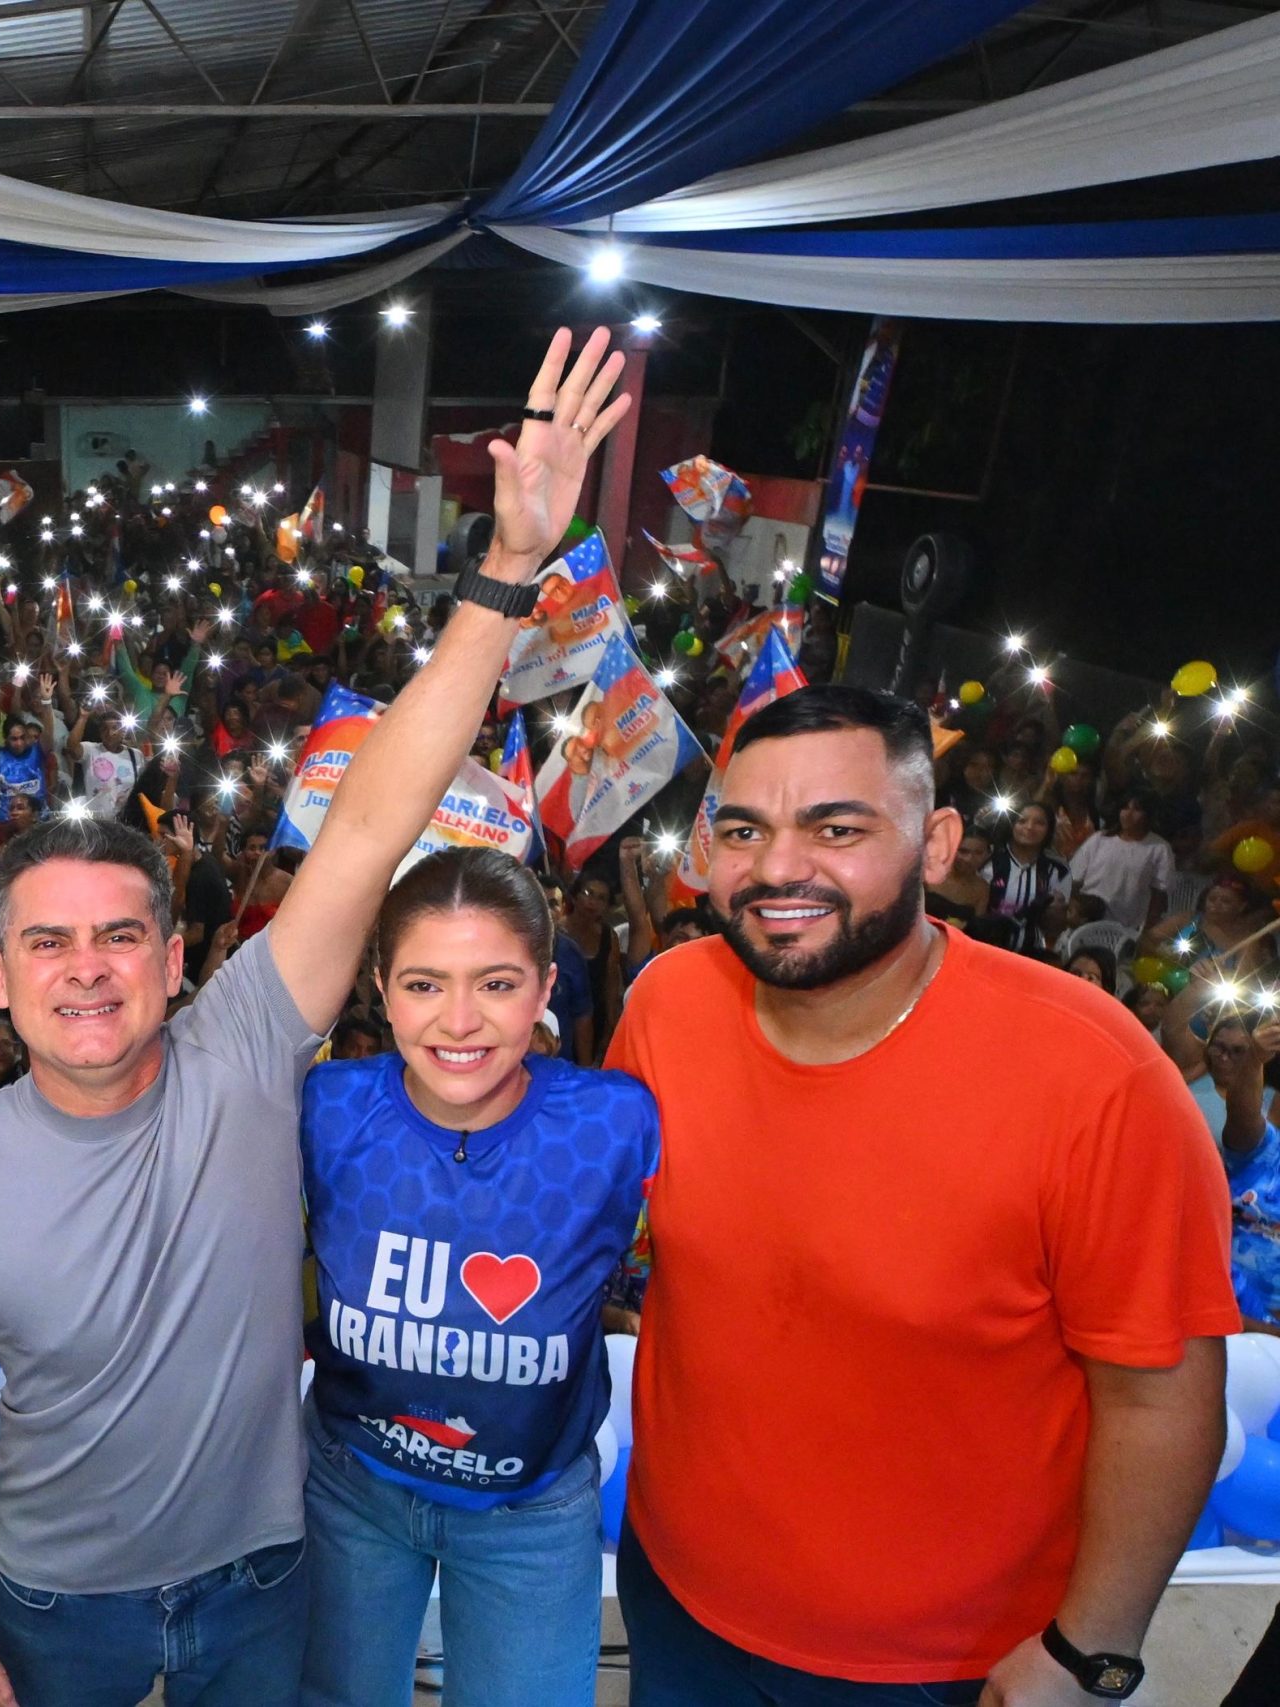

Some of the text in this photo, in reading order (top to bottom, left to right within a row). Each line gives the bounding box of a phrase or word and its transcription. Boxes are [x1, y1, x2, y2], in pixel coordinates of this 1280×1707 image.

[430, 809, 509, 844] ALHANO
[440, 794, 526, 833] ARCELO
[366, 1230, 450, 1319] EU
[329, 1299, 569, 1386] IRANDUBA
[357, 1414, 524, 1476] MARCELO
[382, 1440, 490, 1485] PALHANO
